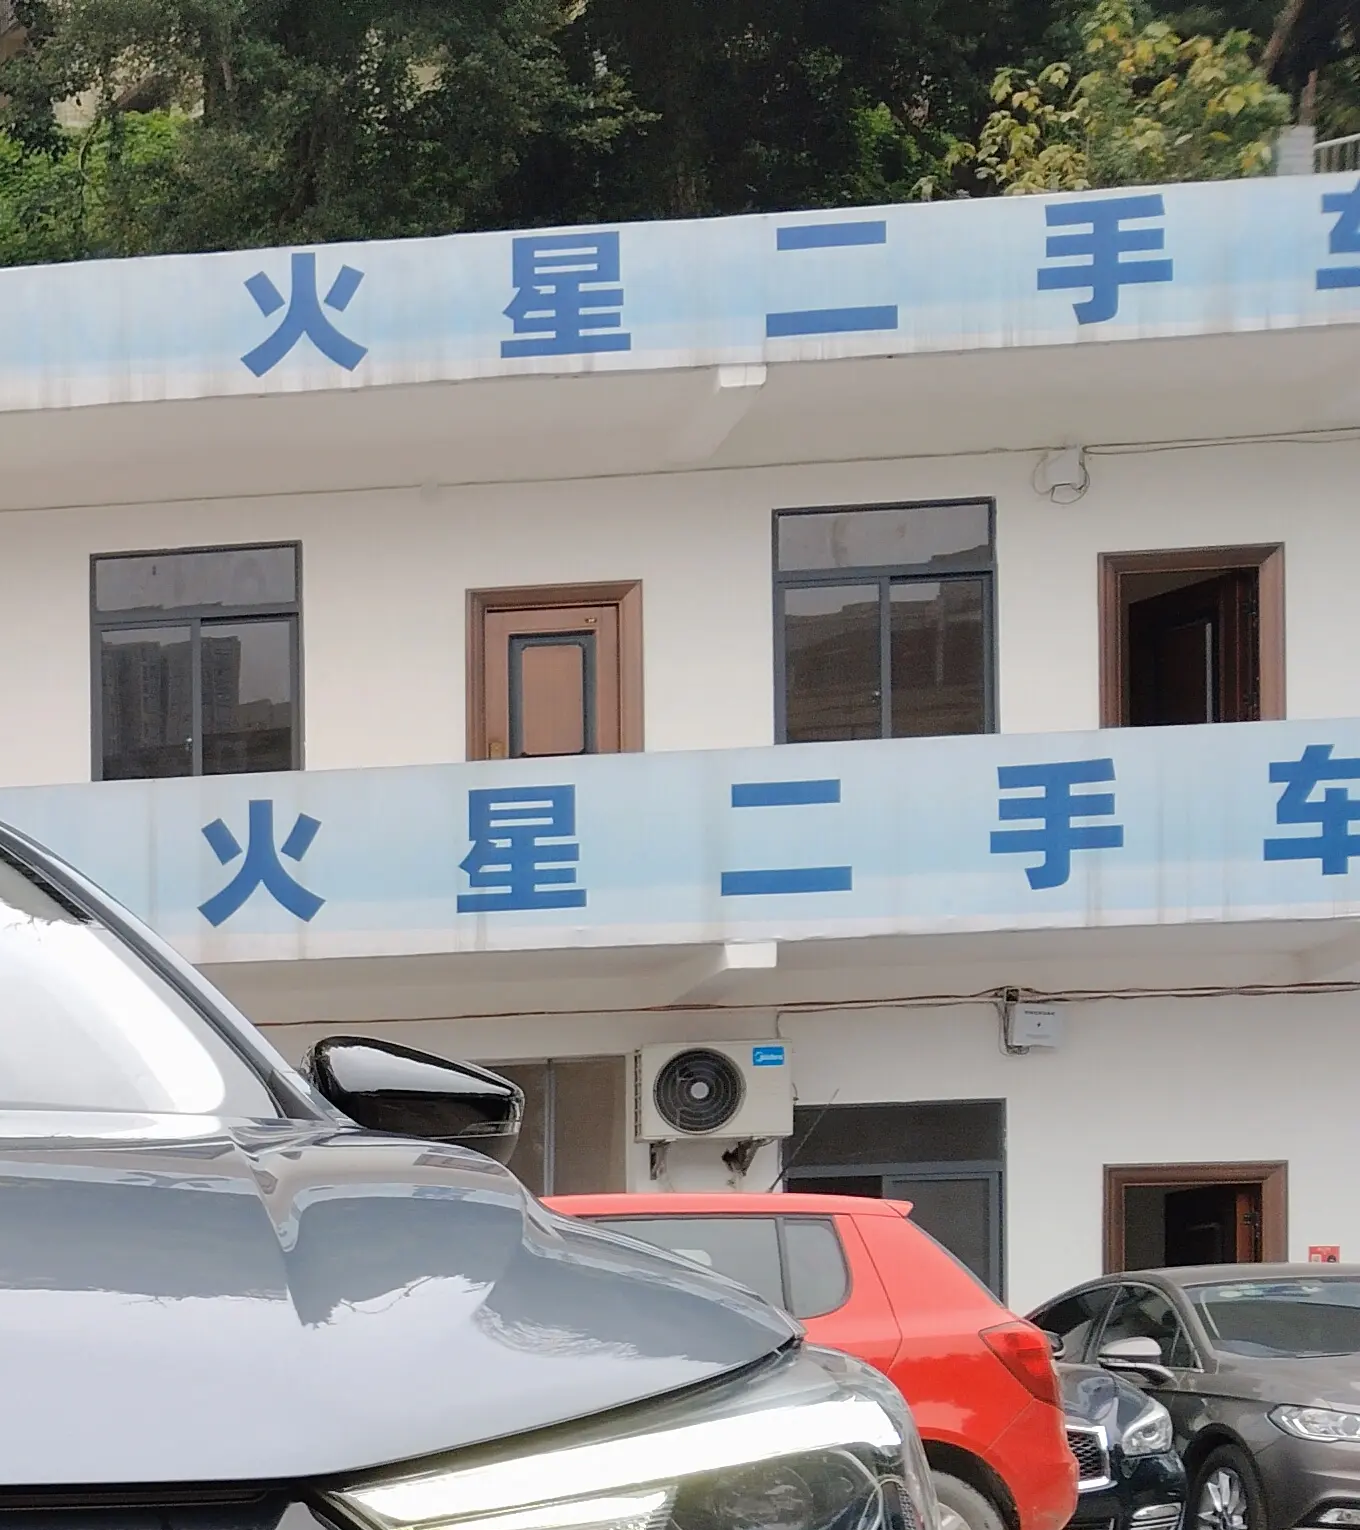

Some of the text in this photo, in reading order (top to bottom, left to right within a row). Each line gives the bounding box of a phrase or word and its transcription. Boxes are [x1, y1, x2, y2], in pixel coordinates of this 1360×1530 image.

[197, 743, 1360, 928] 火星二手车
